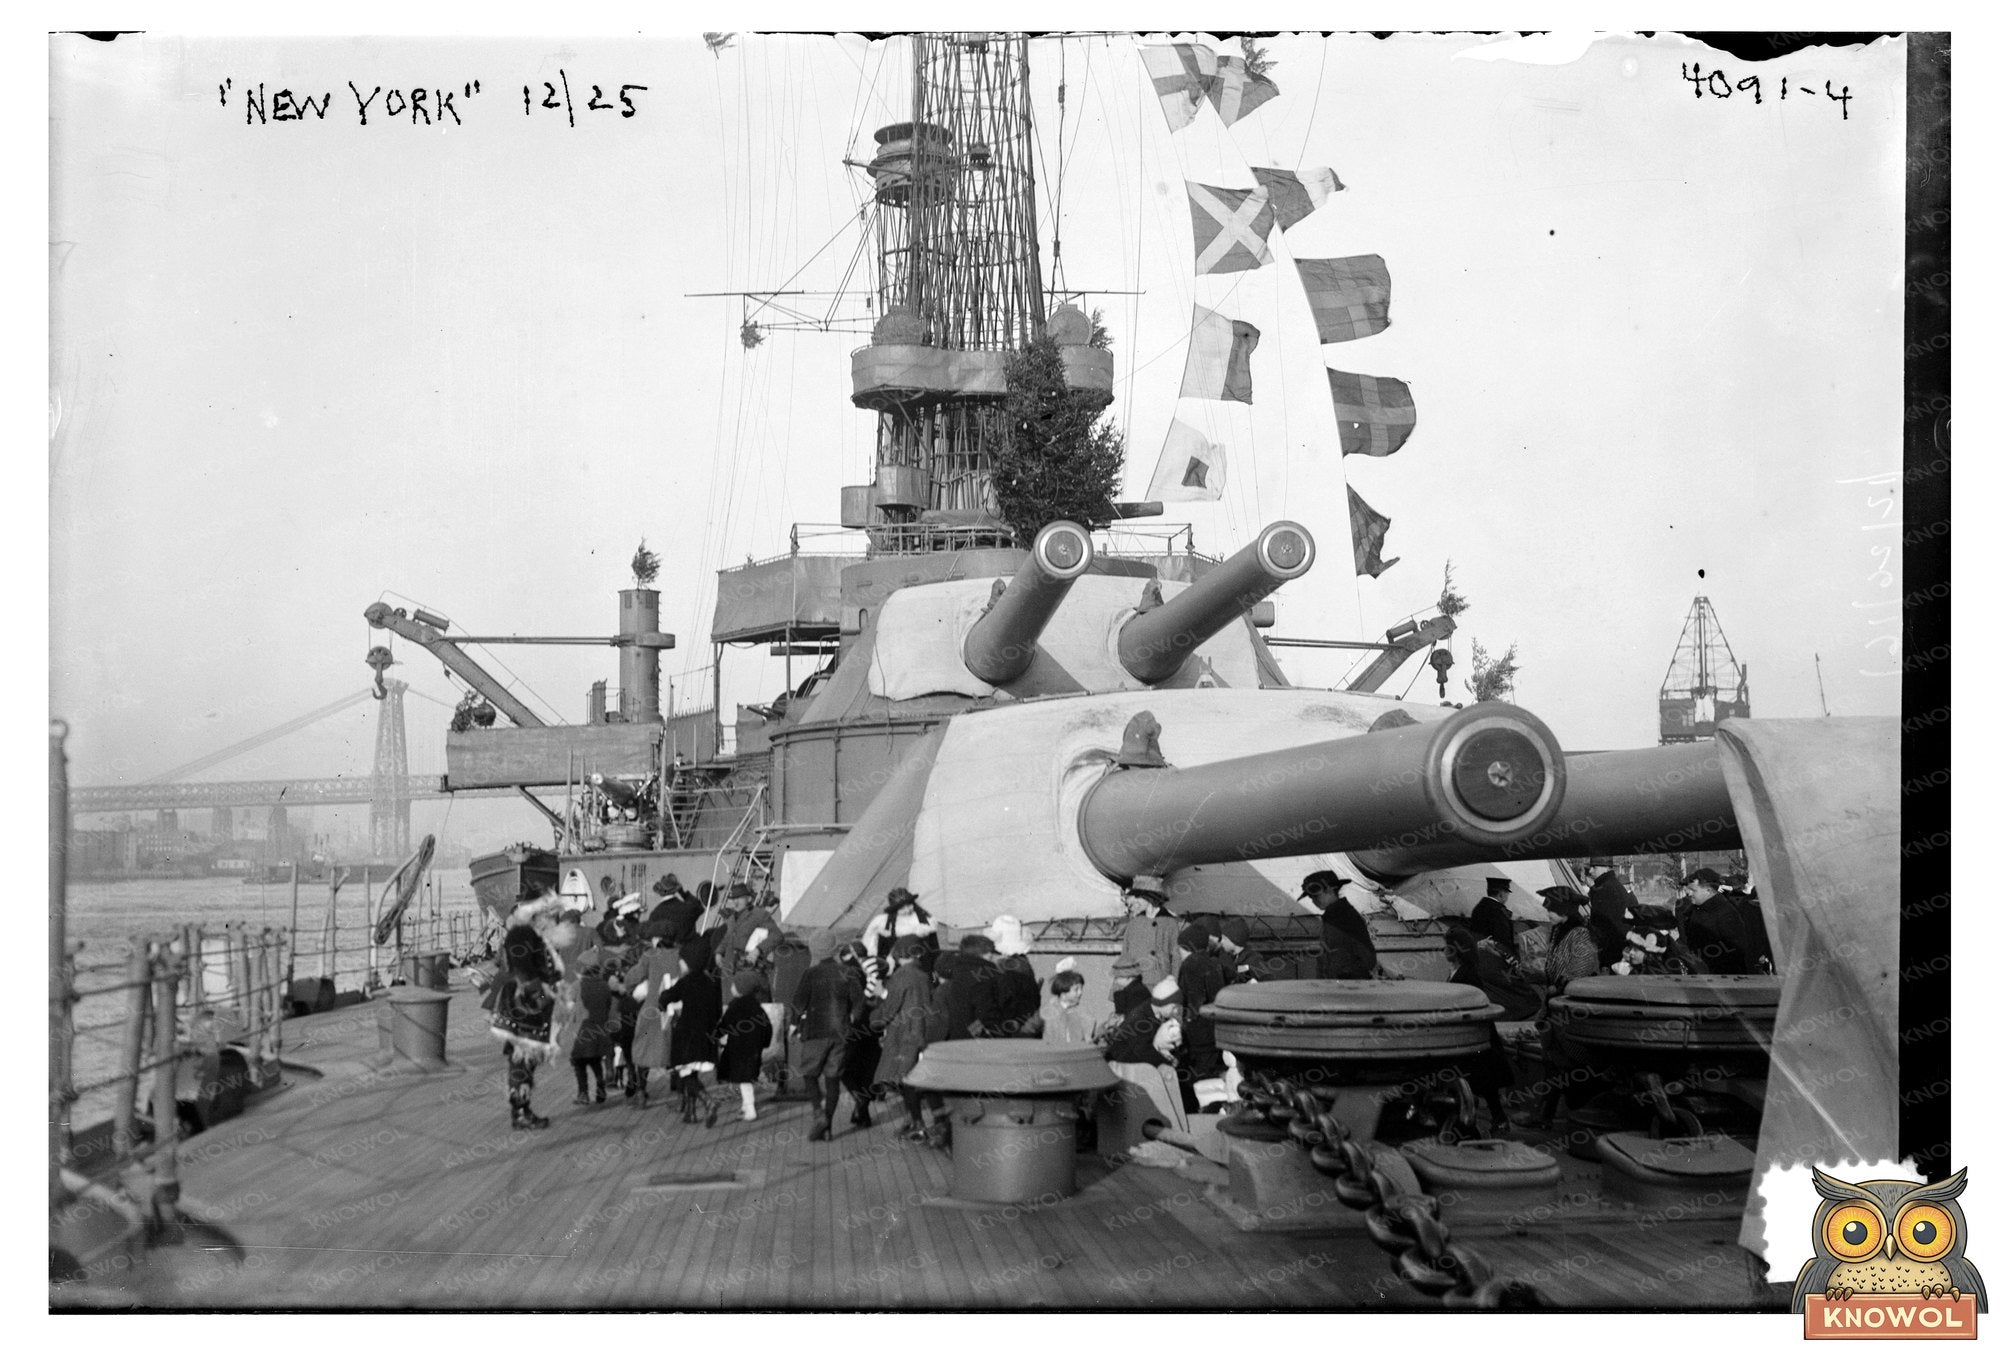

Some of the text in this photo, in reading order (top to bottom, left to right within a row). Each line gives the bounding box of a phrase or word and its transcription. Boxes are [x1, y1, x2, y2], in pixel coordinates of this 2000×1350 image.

[349, 80, 480, 125] YORK"
[524, 69, 647, 127] 12/25
[1683, 62, 1852, 120] 4091-4
